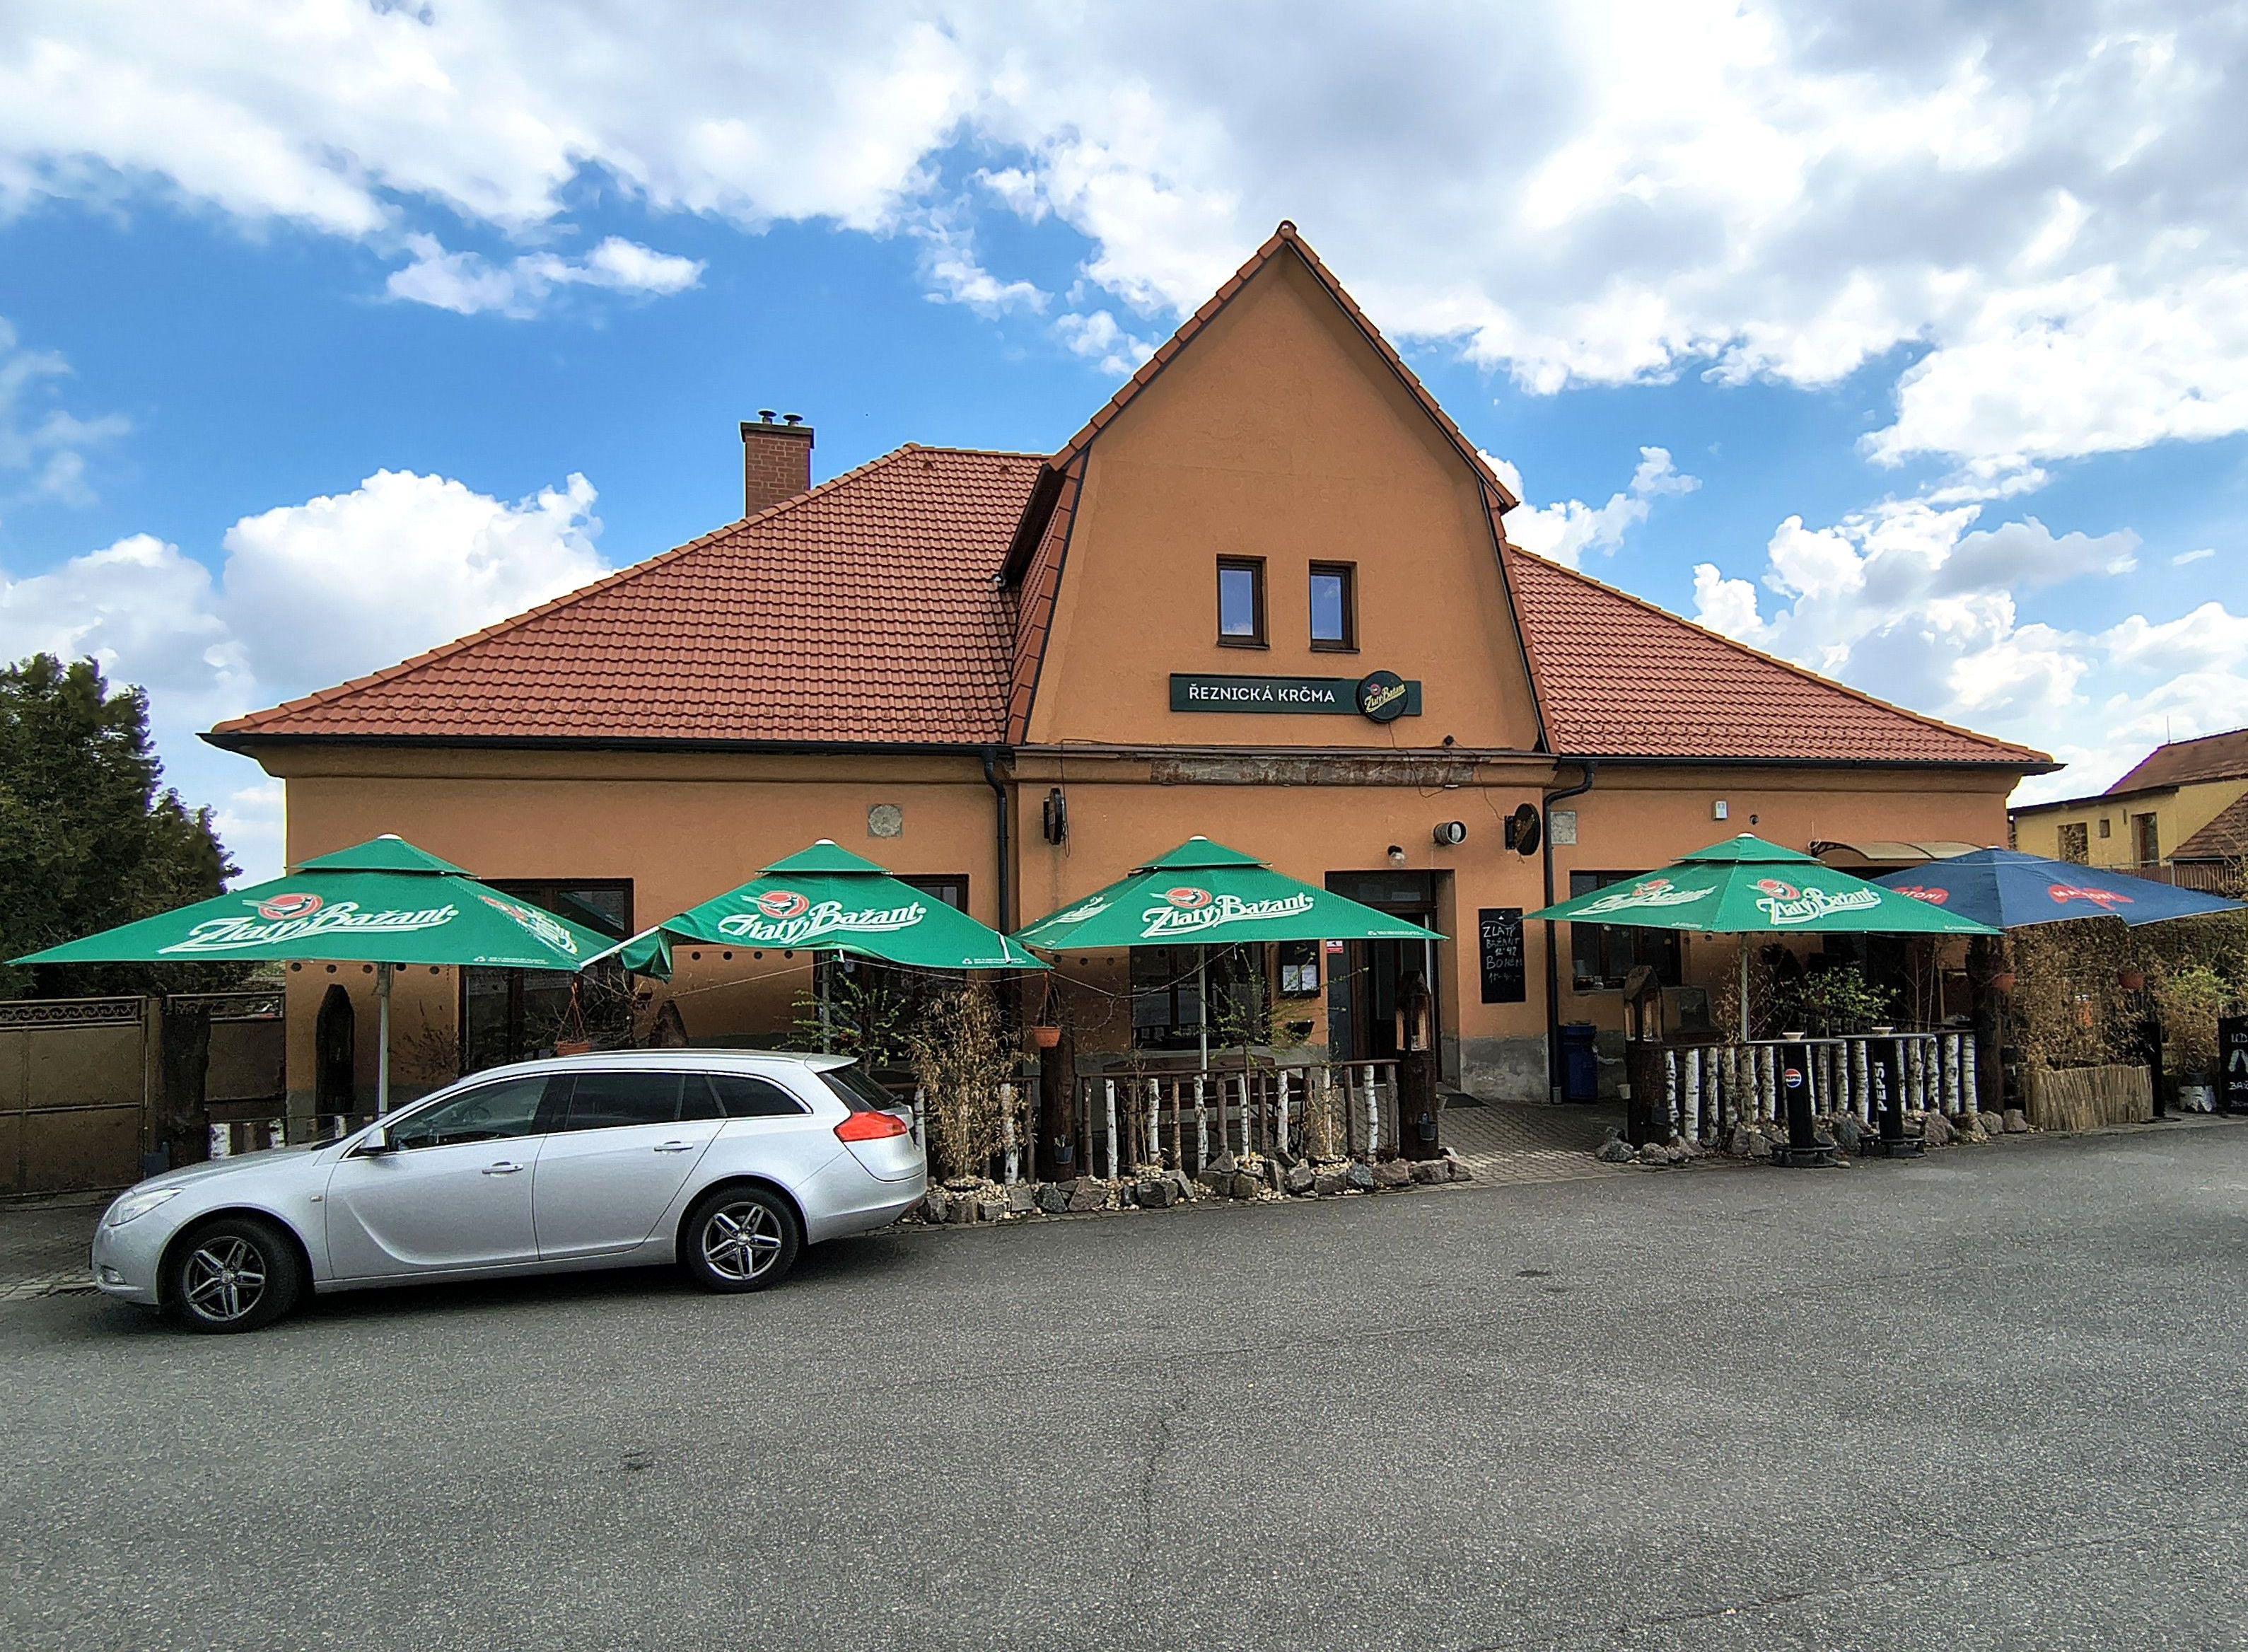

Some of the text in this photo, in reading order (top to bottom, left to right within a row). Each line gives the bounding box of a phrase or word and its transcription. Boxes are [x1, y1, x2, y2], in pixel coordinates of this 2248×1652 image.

[1189, 683, 1336, 703] ŘEZNICKÁ KRČMA
[310, 901, 459, 933] Bažant
[808, 900, 927, 932] Bažant
[1214, 892, 1314, 922] Bažant
[1803, 887, 1882, 918] Bažant
[1874, 1061, 1887, 1112] PEPSI
